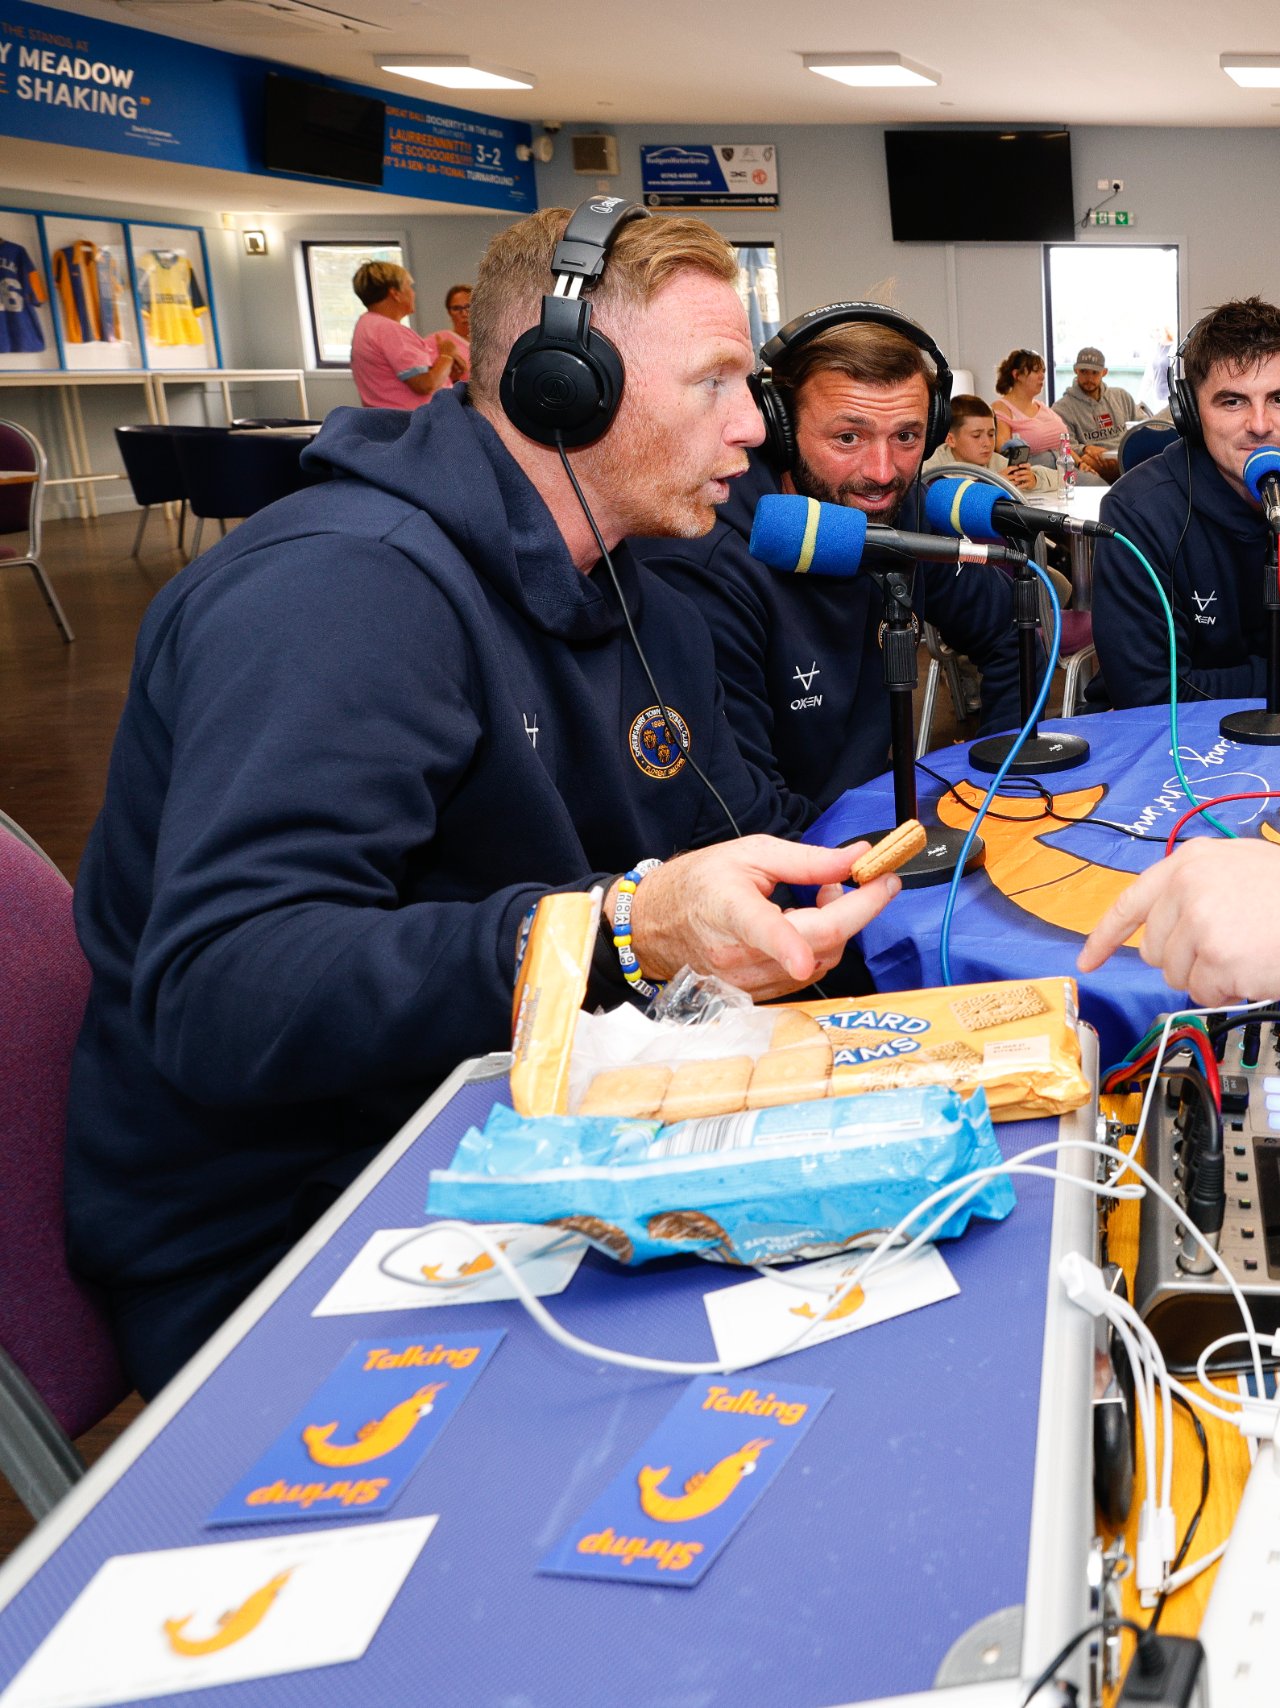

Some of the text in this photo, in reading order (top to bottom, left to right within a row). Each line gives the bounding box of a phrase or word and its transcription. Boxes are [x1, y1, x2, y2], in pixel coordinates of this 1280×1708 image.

[19, 46, 134, 89] MEADOW
[1084, 423, 1128, 441] NORWAY
[790, 695, 823, 710] OXEN
[363, 1344, 480, 1371] Talking
[703, 1386, 808, 1426] Talking
[245, 1478, 390, 1508] Shrimp
[577, 1527, 704, 1570] Shrimp
